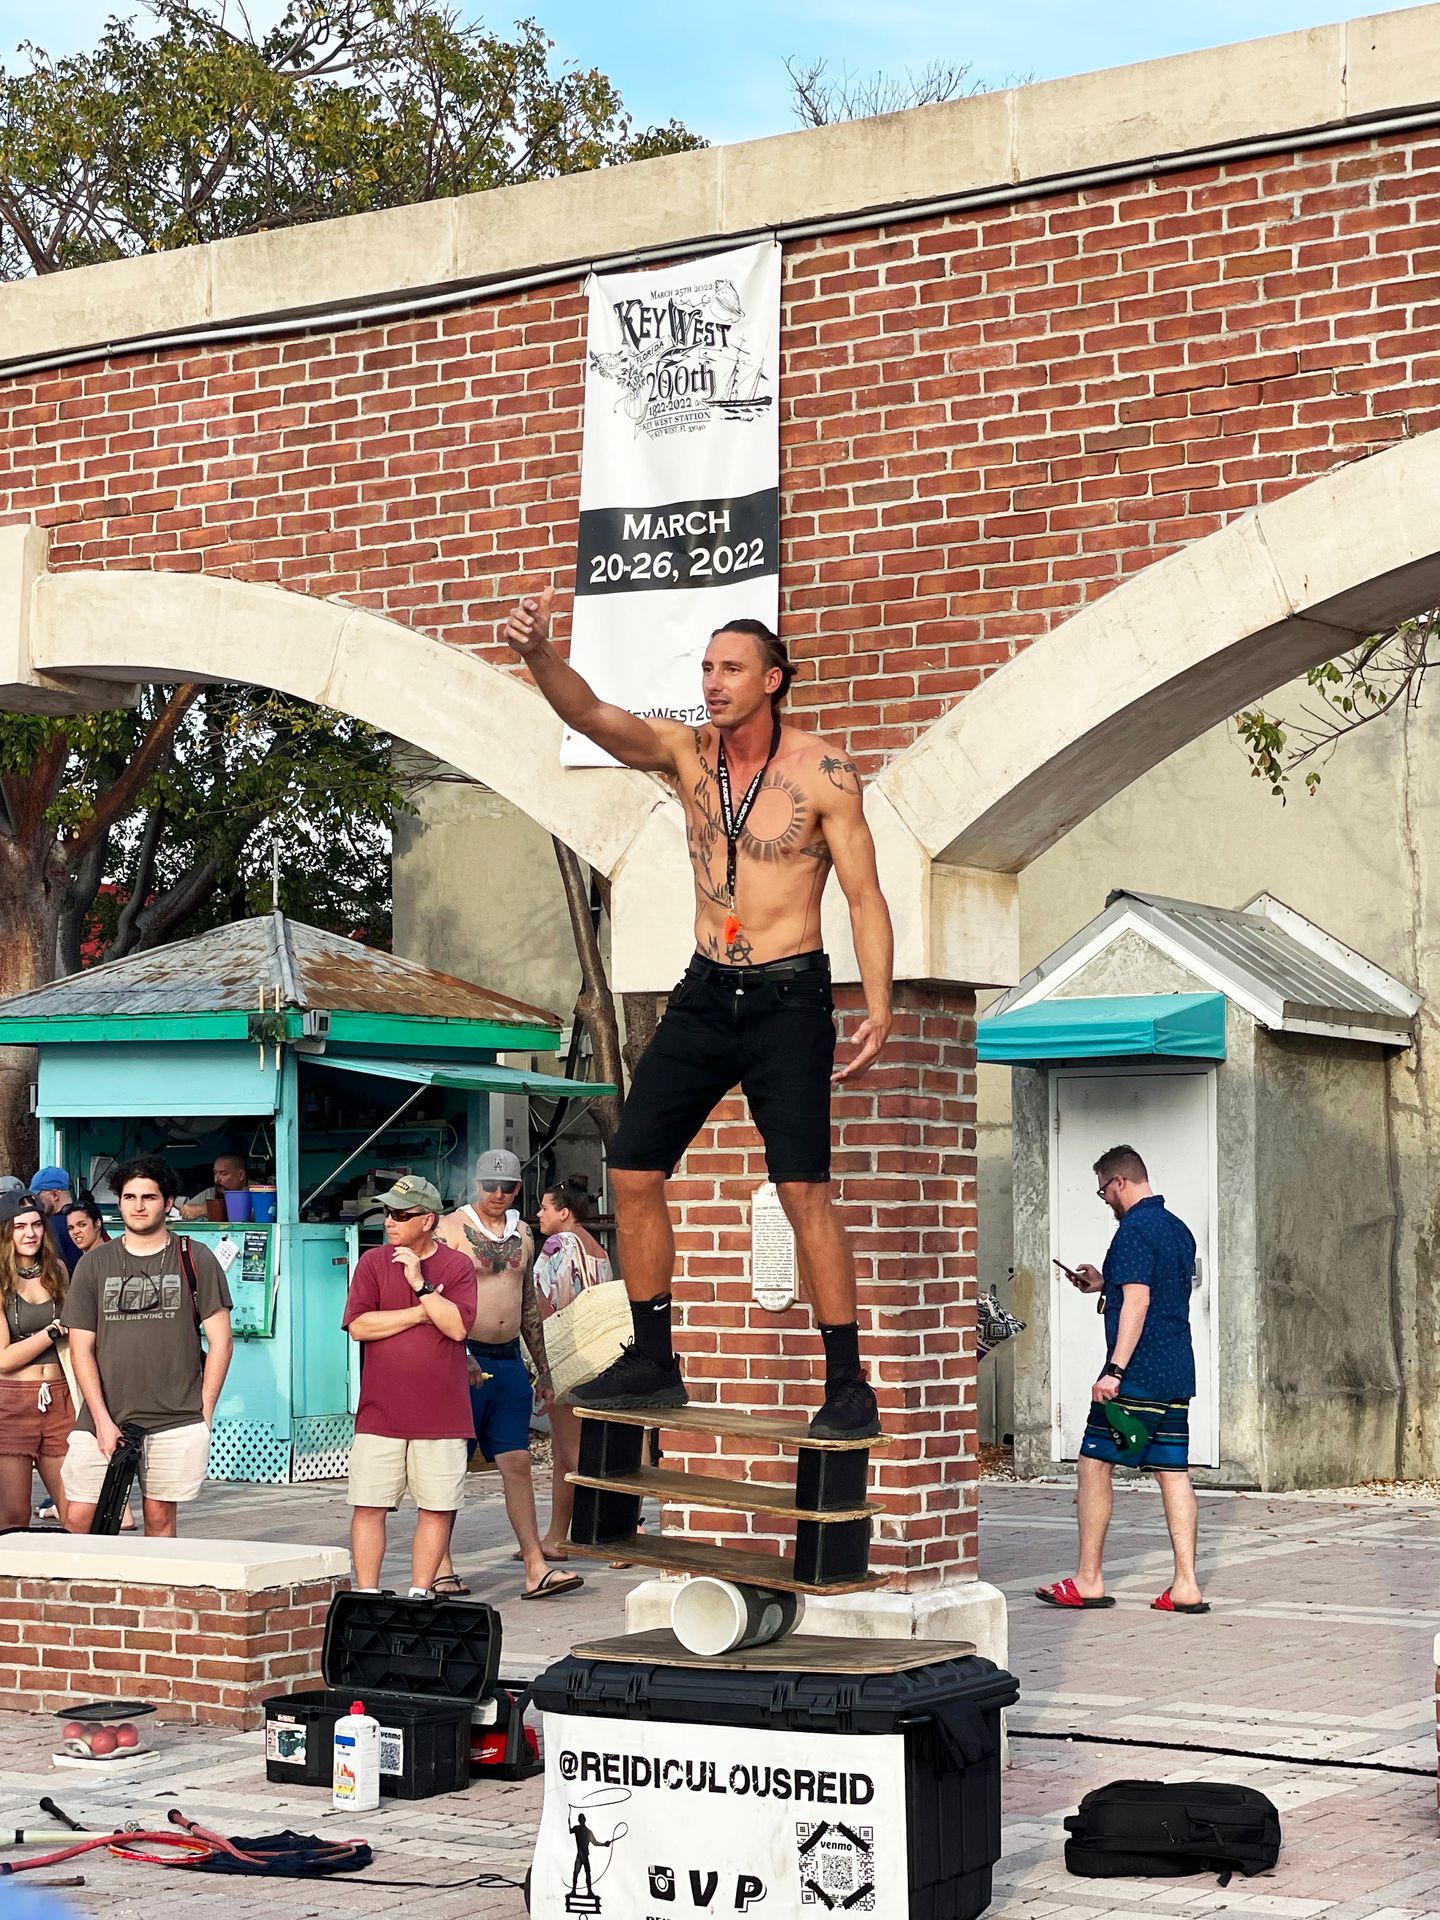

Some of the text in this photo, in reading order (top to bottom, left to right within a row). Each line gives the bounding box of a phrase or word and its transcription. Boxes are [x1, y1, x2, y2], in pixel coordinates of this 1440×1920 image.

[675, 286, 692, 297] 25TH
[693, 283, 713, 293] 2022
[613, 297, 732, 352] KEY WEST
[636, 341, 664, 364] FLORIDA
[646, 361, 717, 402] 200th
[648, 397, 692, 417] 1822-2022
[654, 417, 673, 427] WEST
[674, 411, 711, 423] STATION
[622, 509, 731, 540] MARCH
[589, 537, 765, 584] 20-26, 2022
[721, 778, 730, 806] UNDER
[735, 802, 750, 828] UNDER
[126, 1312, 163, 1321] BREWING
[380, 1731, 402, 1741] venmo
[559, 1750, 875, 1805] @REIDICULOUSREID
[820, 1840, 853, 1851] venmo
